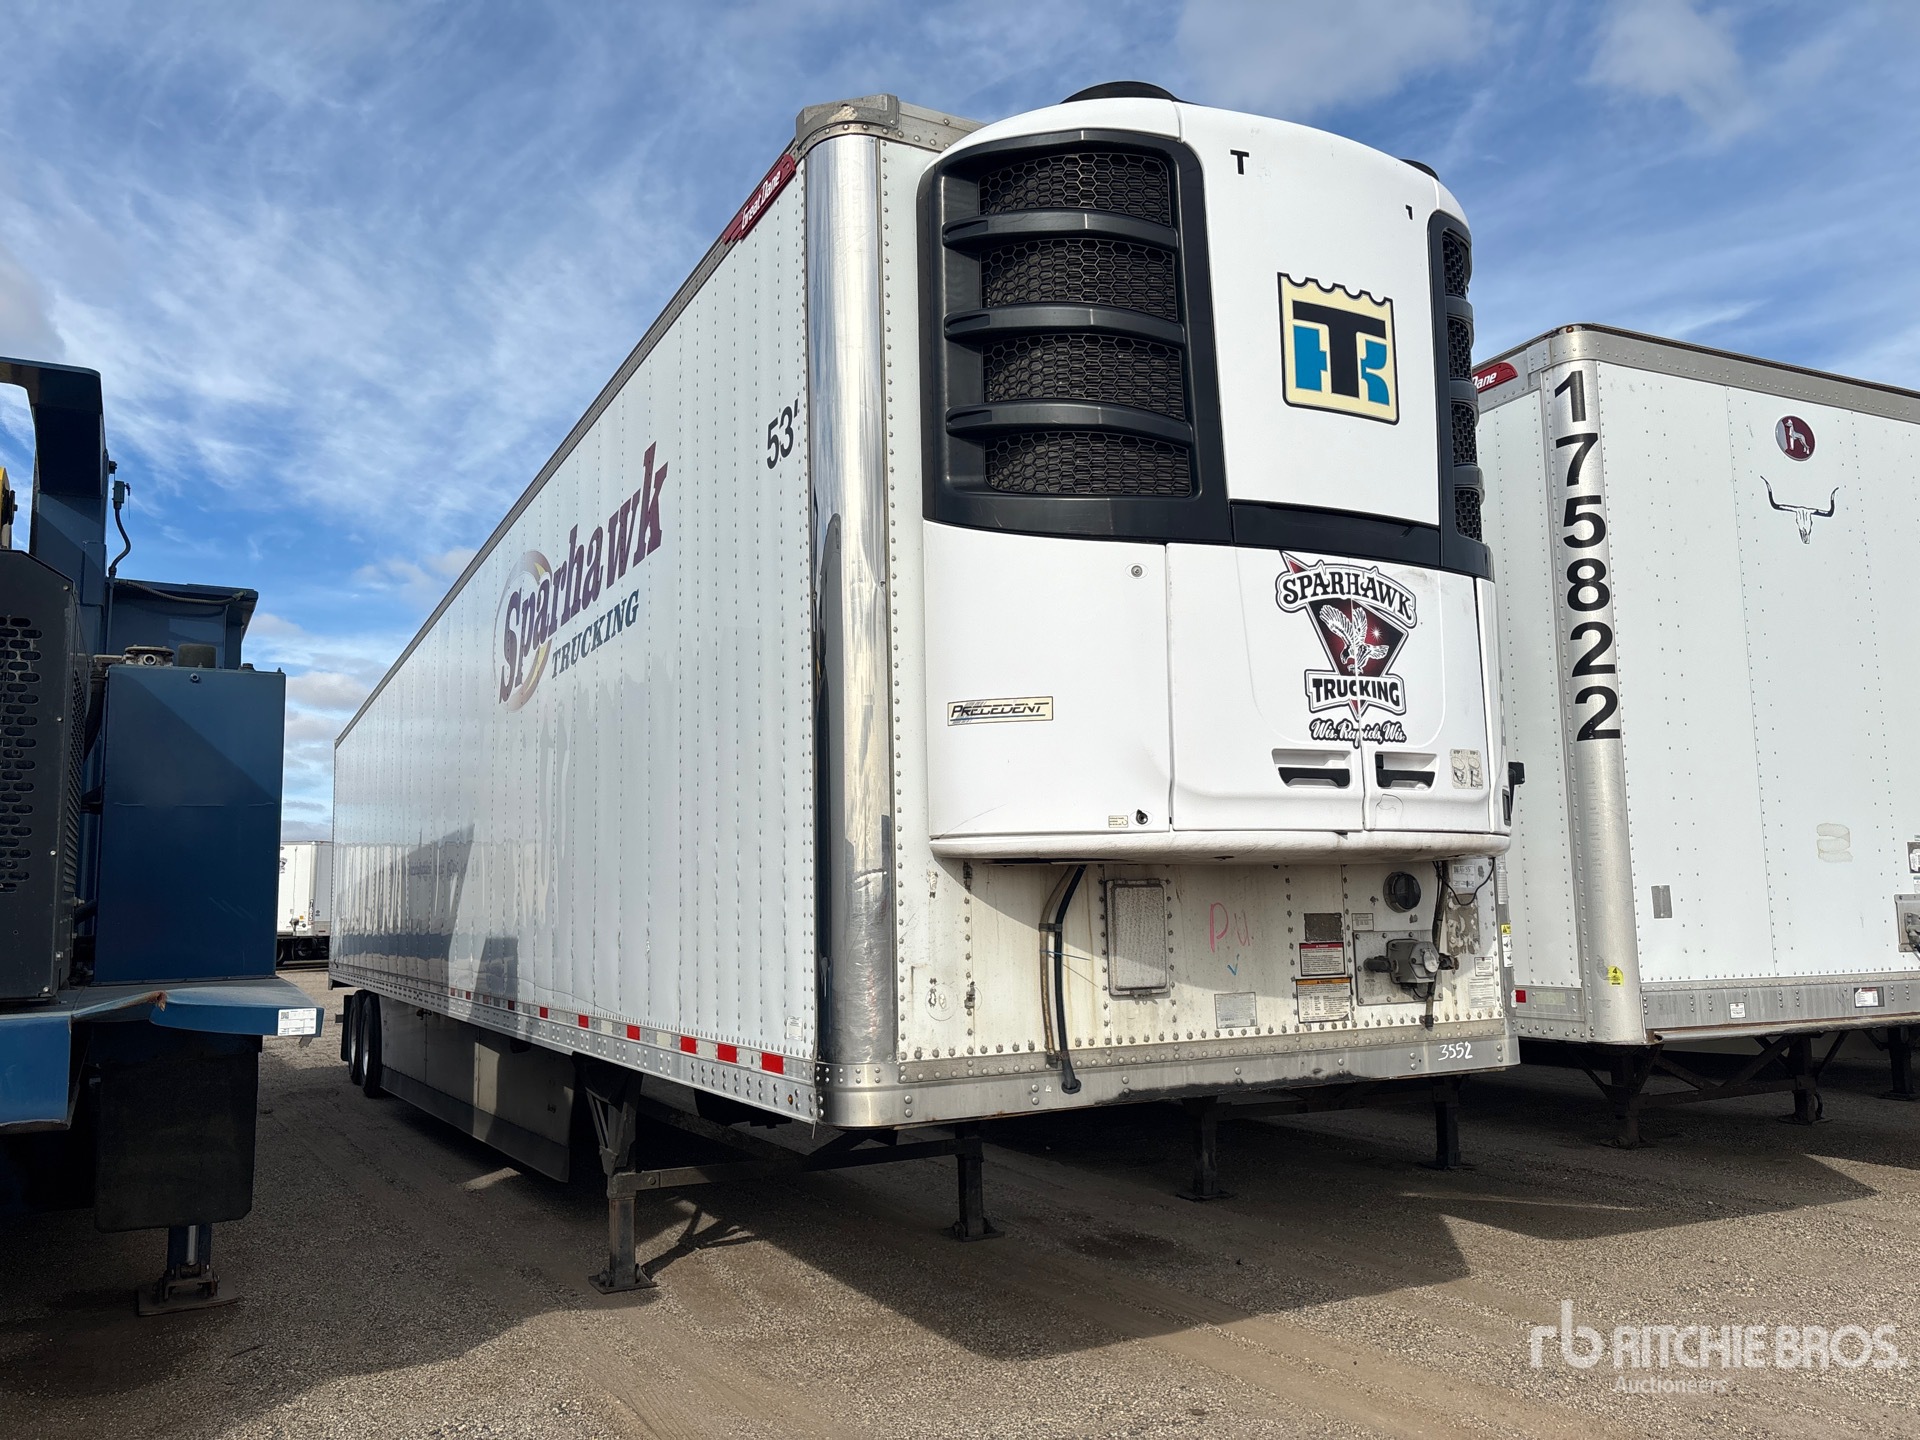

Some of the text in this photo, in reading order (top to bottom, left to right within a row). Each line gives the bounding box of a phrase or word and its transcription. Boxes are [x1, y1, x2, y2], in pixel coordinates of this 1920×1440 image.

[741, 170, 782, 231] Great Dane
[499, 440, 668, 704] Sparhawk
[1282, 570, 1414, 621] SPARHAWK
[551, 588, 640, 680] TRUCKING
[1312, 678, 1400, 707] TRUCKING
[1437, 1040, 1474, 1061] 3552
